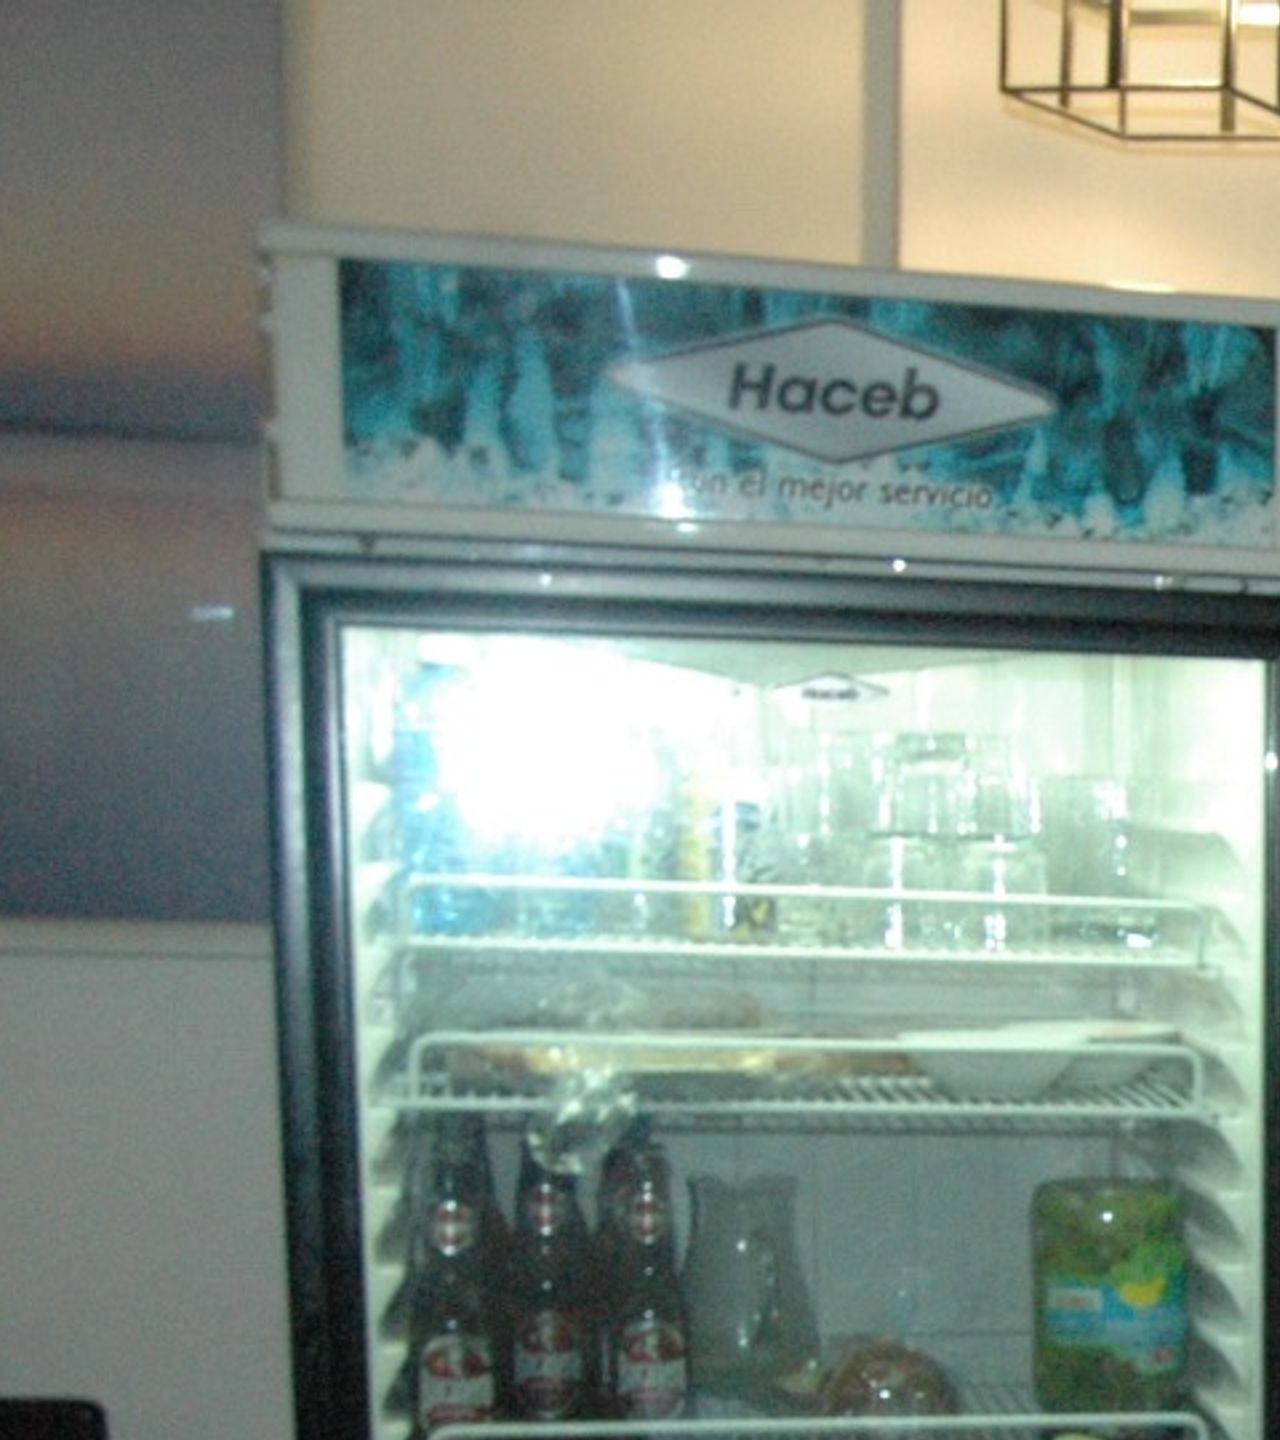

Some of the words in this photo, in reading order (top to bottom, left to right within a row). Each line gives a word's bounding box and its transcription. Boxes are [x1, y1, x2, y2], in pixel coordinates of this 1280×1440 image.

[729, 362, 940, 421] Haceb
[738, 468, 767, 496] el
[778, 474, 865, 508] mejor
[879, 481, 994, 509] servicio
